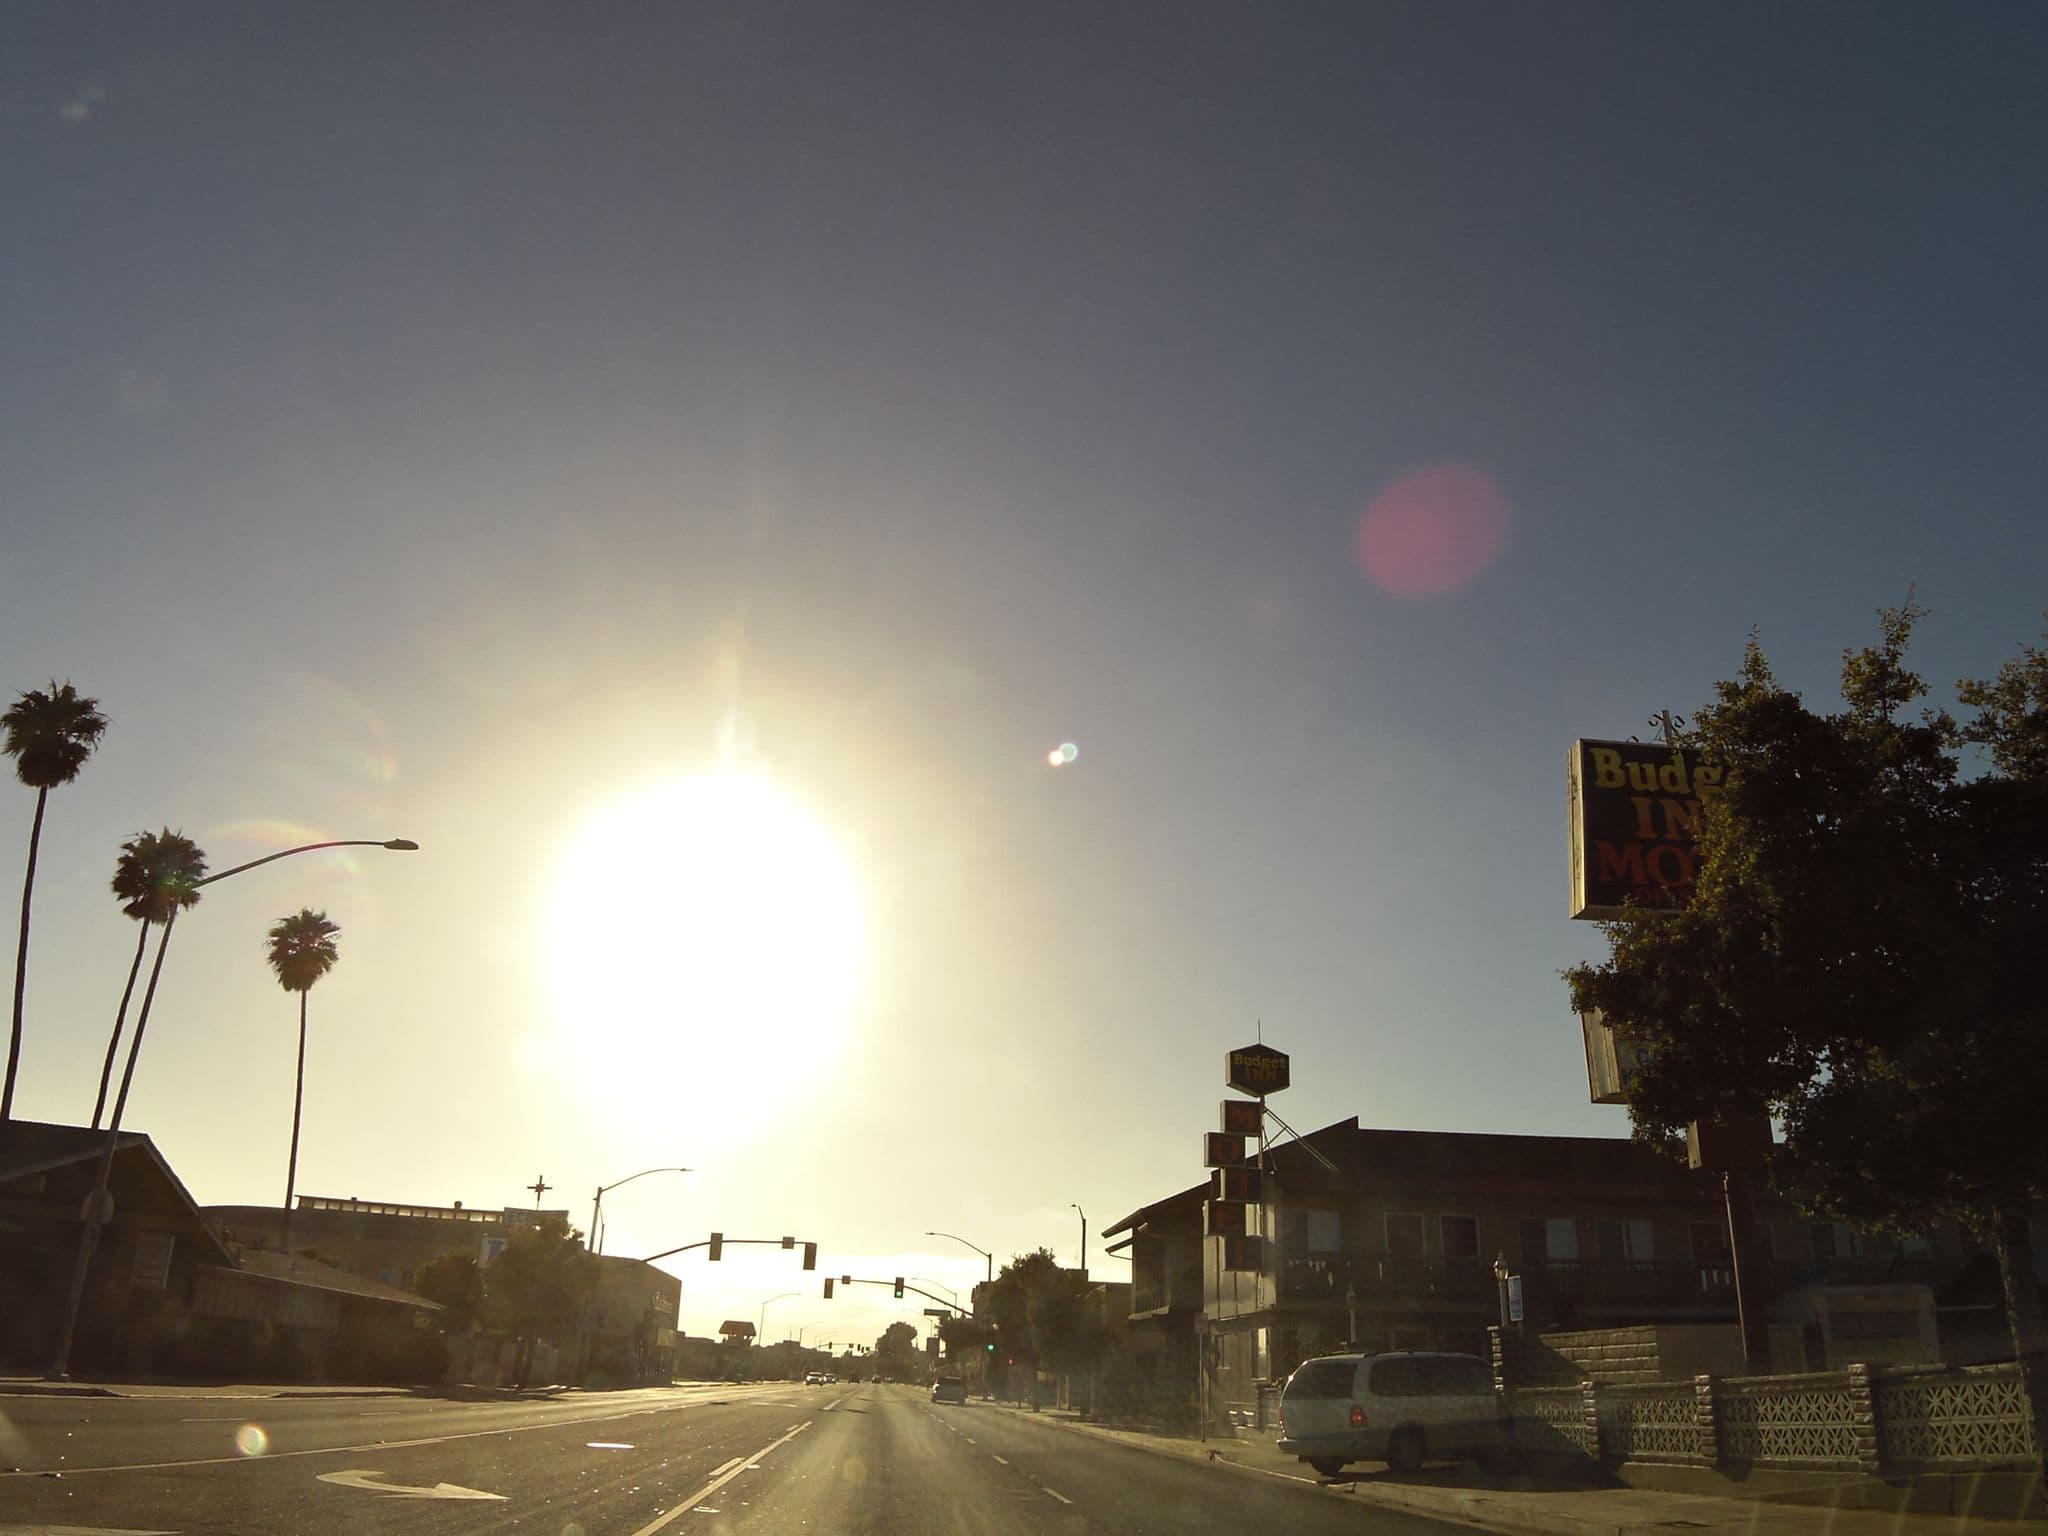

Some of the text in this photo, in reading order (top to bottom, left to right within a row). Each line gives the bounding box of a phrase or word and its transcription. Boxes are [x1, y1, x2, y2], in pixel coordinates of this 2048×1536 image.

[1589, 747, 1724, 800] Budg
[1593, 841, 1711, 888] MO
[1234, 1053, 1287, 1069] Budget
[1244, 1065, 1277, 1081] INN
